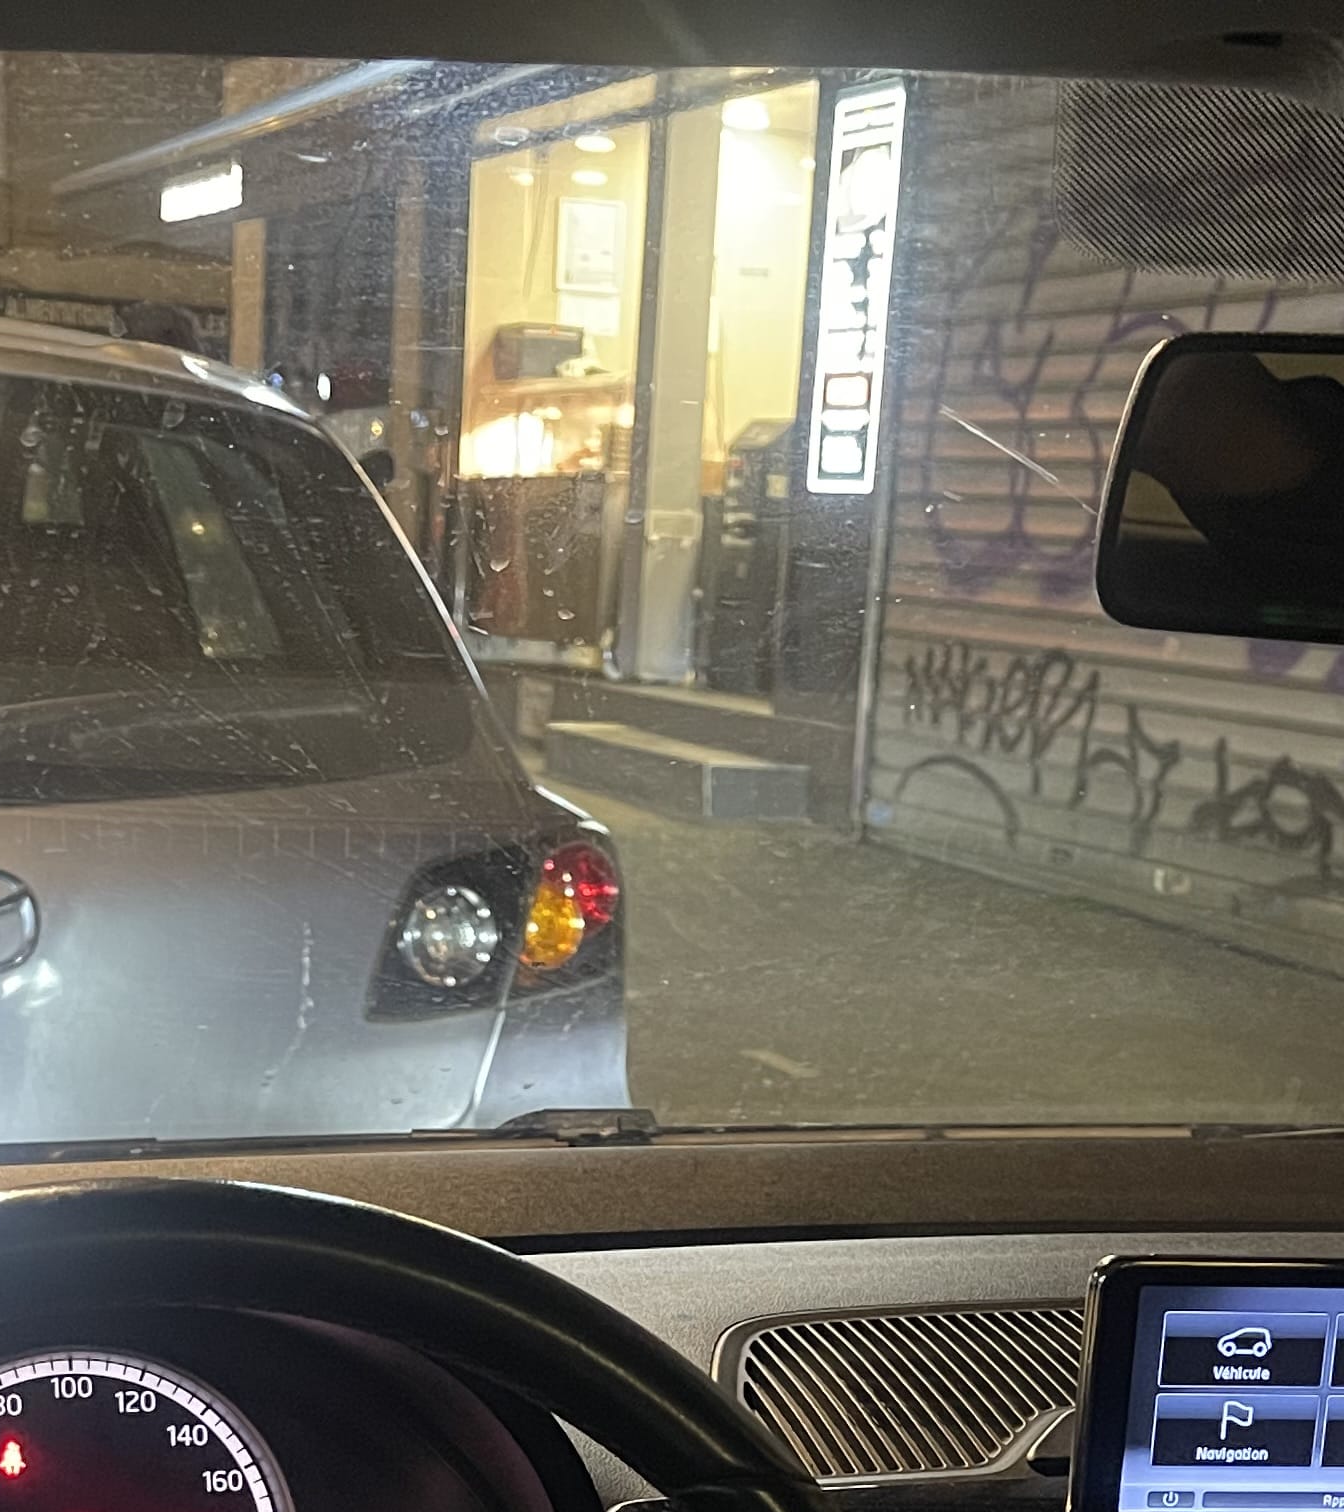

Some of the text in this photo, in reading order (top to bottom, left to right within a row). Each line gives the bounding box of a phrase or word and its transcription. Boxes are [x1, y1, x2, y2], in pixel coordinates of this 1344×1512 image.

[1212, 1365, 1270, 1381] Véhicule
[50, 1376, 93, 1399] 100
[114, 1390, 156, 1414] 120
[166, 1424, 208, 1447] 140
[1195, 1446, 1269, 1463] Navigation
[202, 1469, 244, 1493] 160
